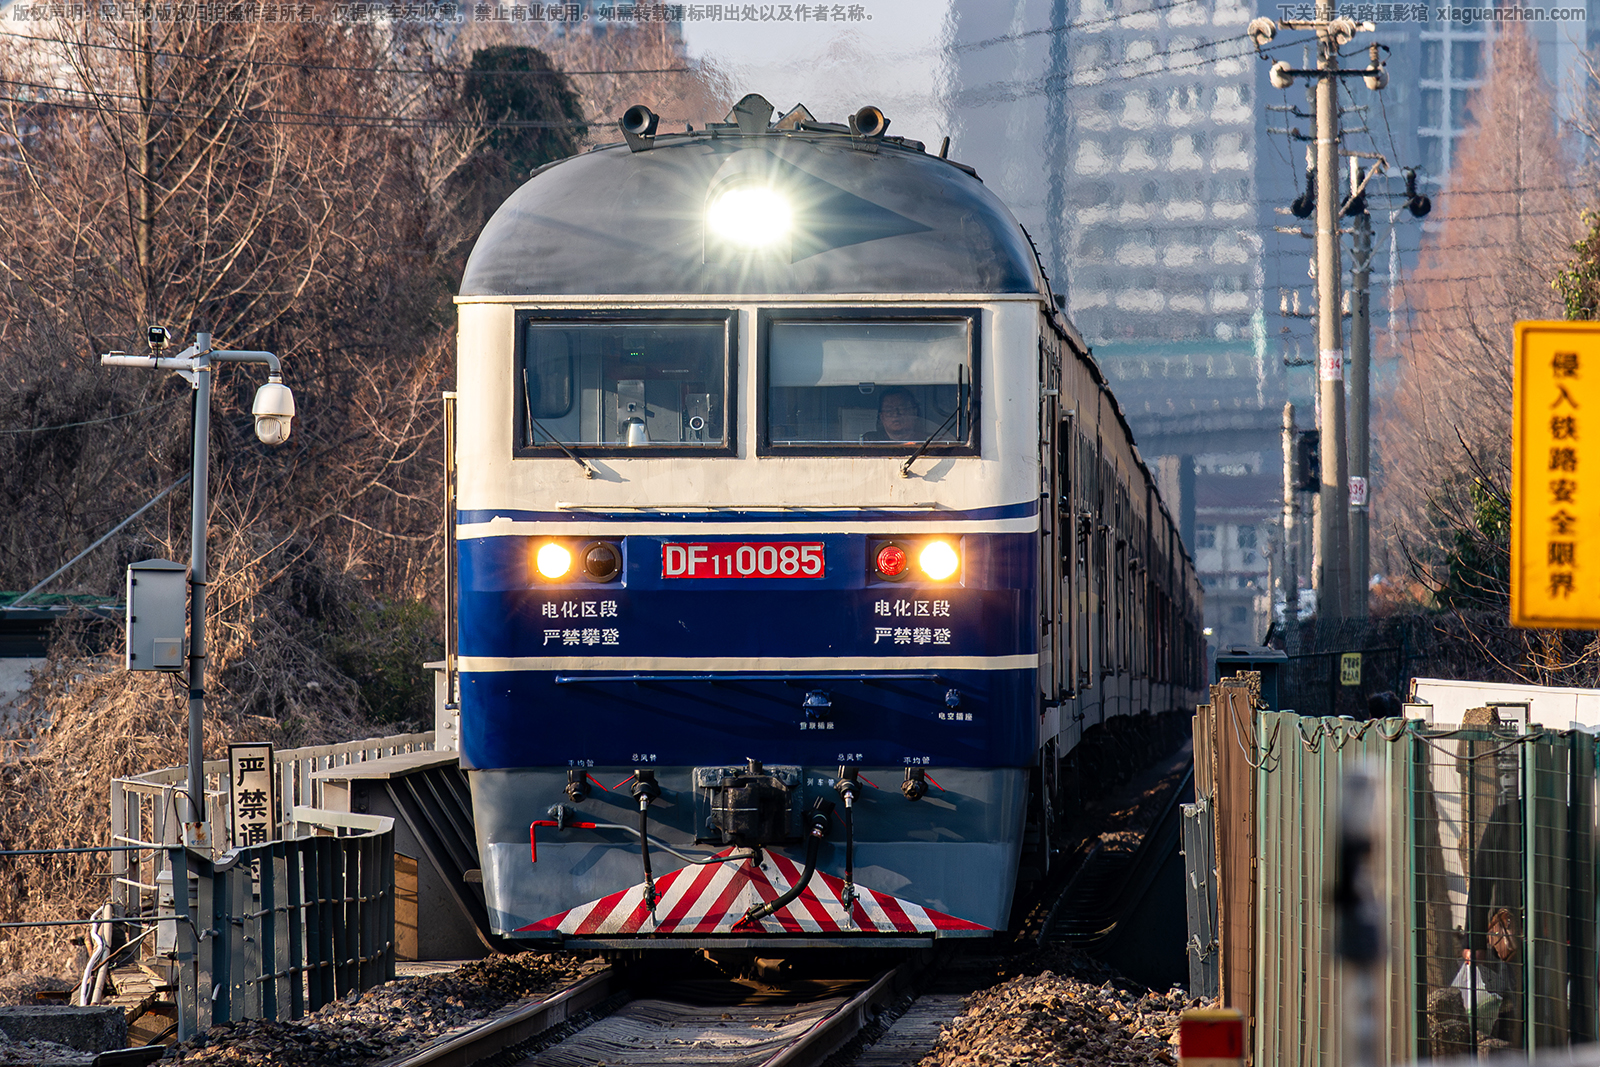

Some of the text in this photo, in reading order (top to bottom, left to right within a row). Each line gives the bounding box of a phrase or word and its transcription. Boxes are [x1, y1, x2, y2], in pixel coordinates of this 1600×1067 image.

[1548, 352, 1580, 600] 侵入铁路安全限界
[541, 600, 618, 619] 电化区段
[874, 599, 951, 618] 电化区段
[543, 628, 620, 647] 严禁攀登
[874, 627, 952, 646] 严禁攀登
[237, 756, 268, 884] 严禁通
